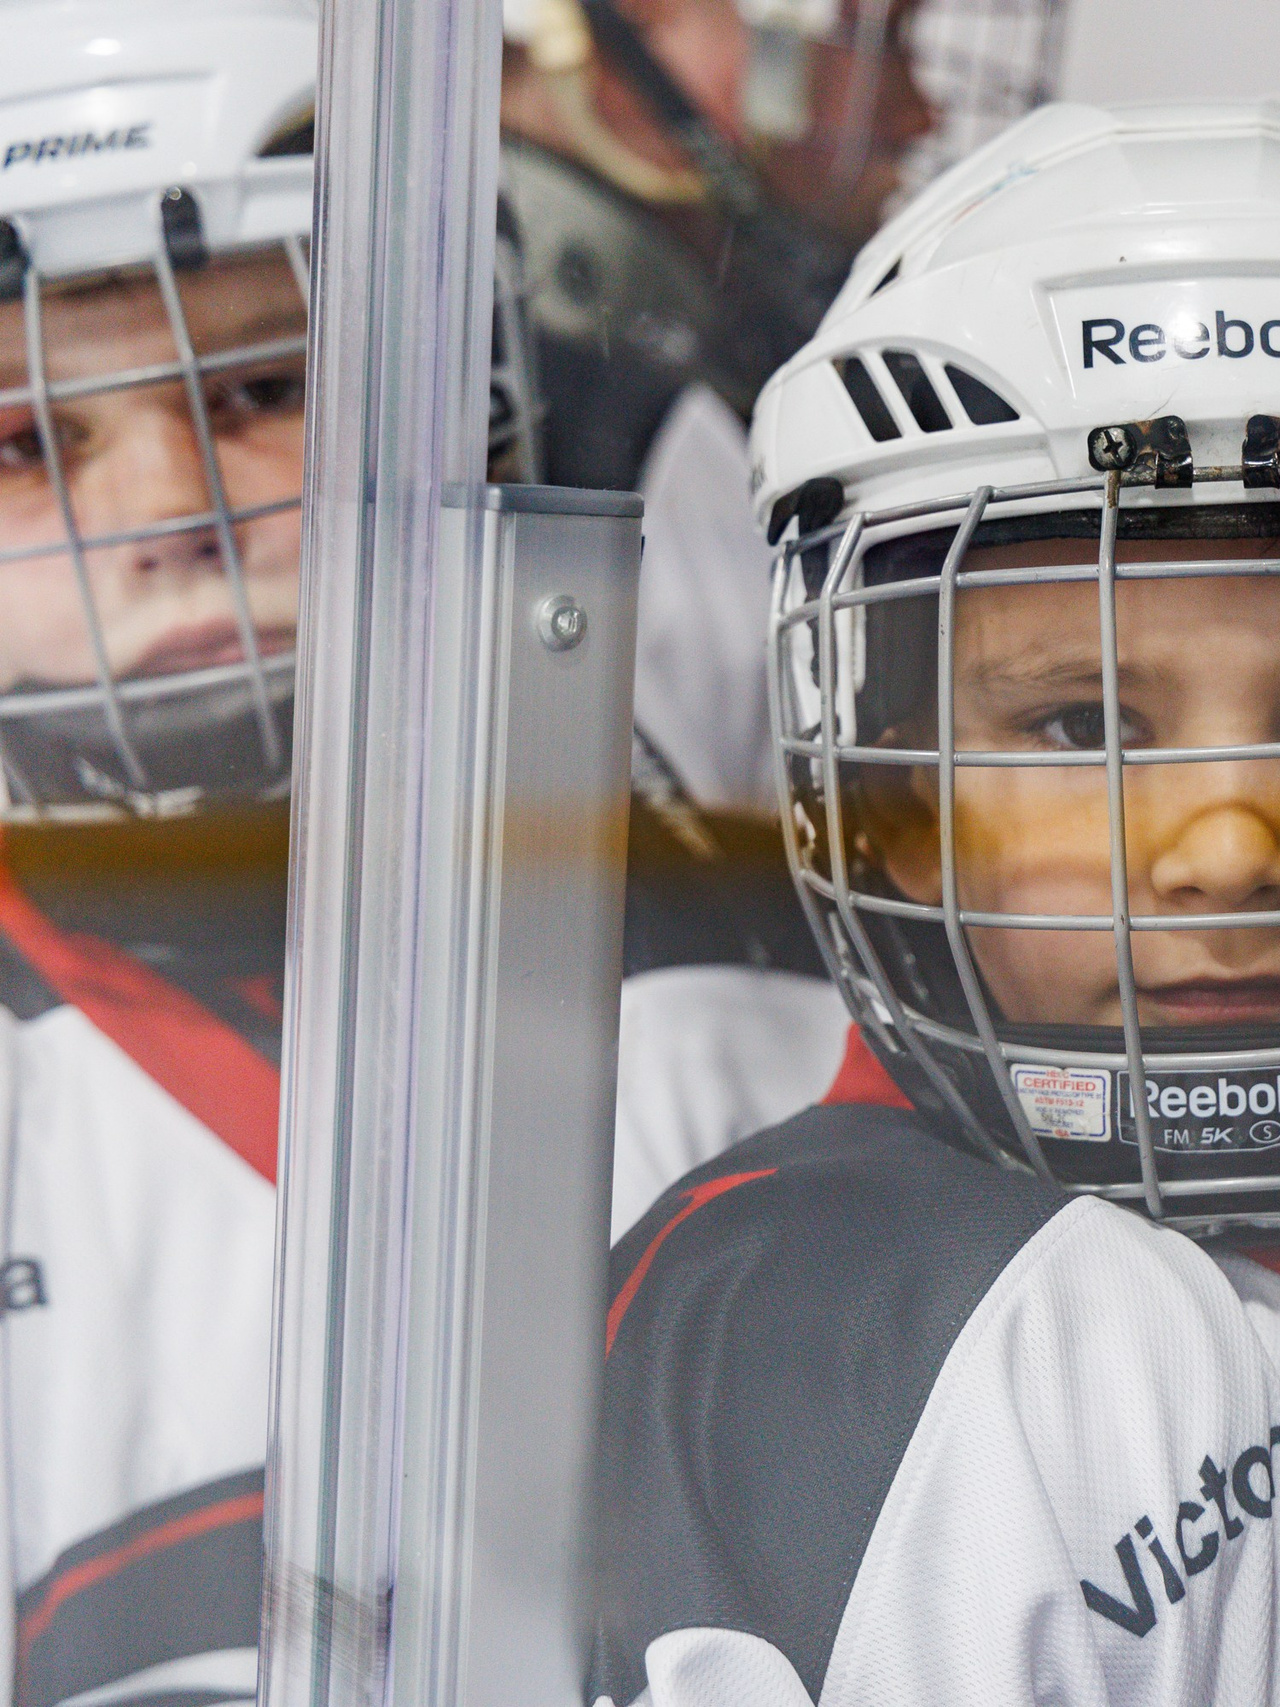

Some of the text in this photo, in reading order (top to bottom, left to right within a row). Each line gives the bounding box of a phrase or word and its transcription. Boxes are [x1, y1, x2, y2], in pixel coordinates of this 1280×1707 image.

[3, 119, 154, 171] PRIME
[1023, 1077, 1096, 1092] CERTIFIED
[1164, 1129, 1190, 1145] FM
[1201, 1127, 1234, 1144] 5K
